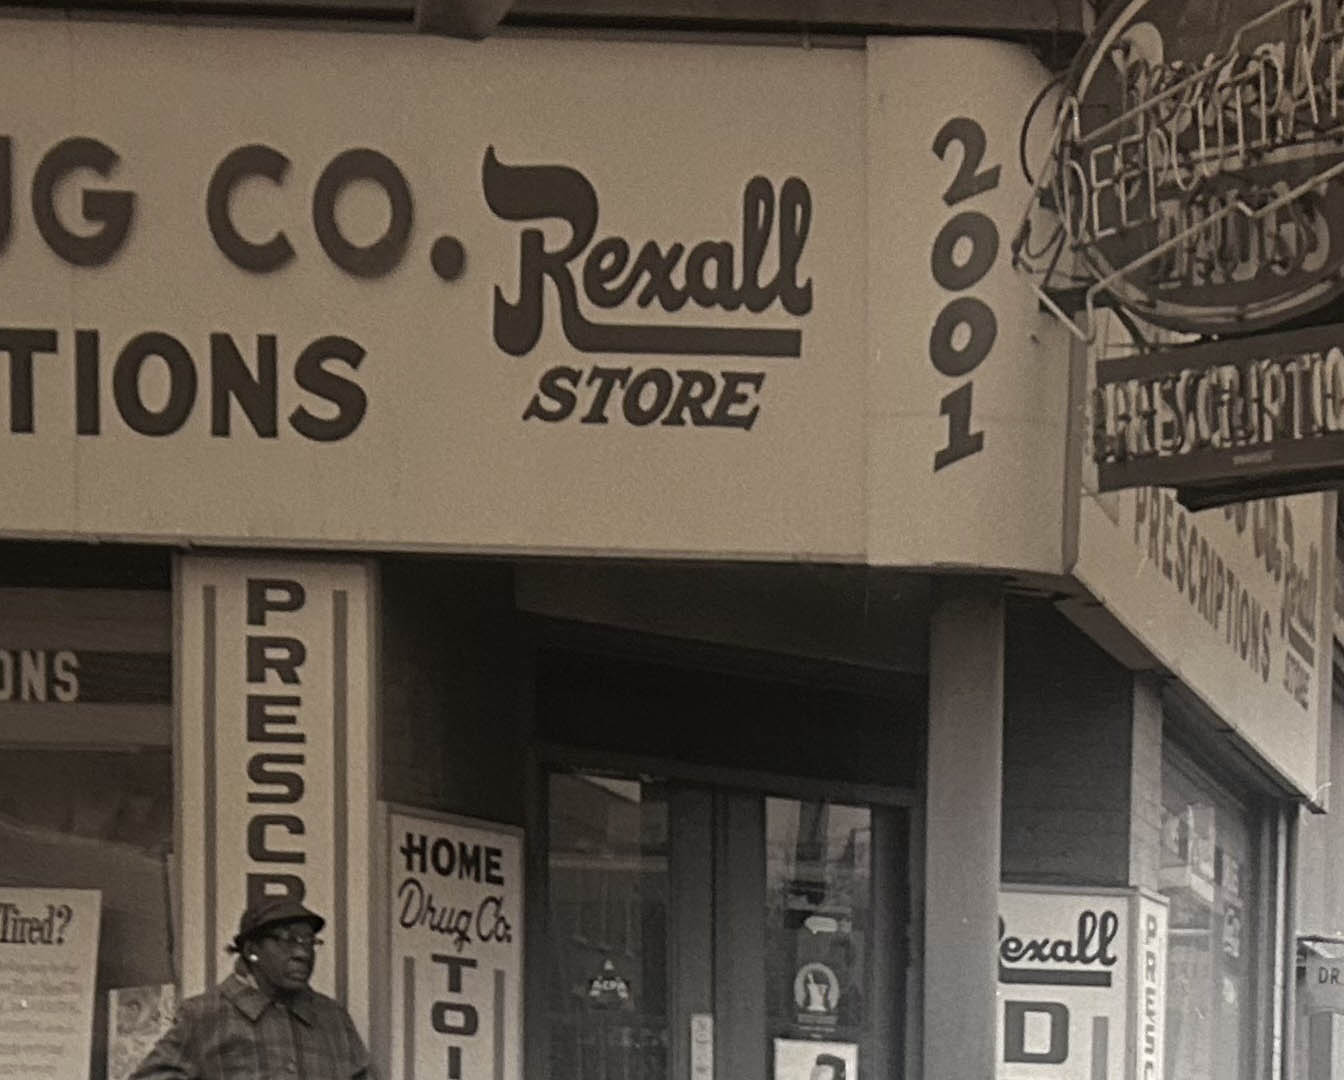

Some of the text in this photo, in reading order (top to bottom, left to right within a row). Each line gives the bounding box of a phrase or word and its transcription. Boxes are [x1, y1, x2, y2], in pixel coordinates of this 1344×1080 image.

[205, 143, 467, 282] CO.
[482, 145, 812, 357] Rexall
[929, 116, 1002, 472] 2001
[522, 366, 766, 431] STORE
[400, 832, 504, 885] HOME
[0, 902, 73, 945] Tired?
[398, 878, 513, 951] Drug Co.
[998, 910, 1119, 967] exall
